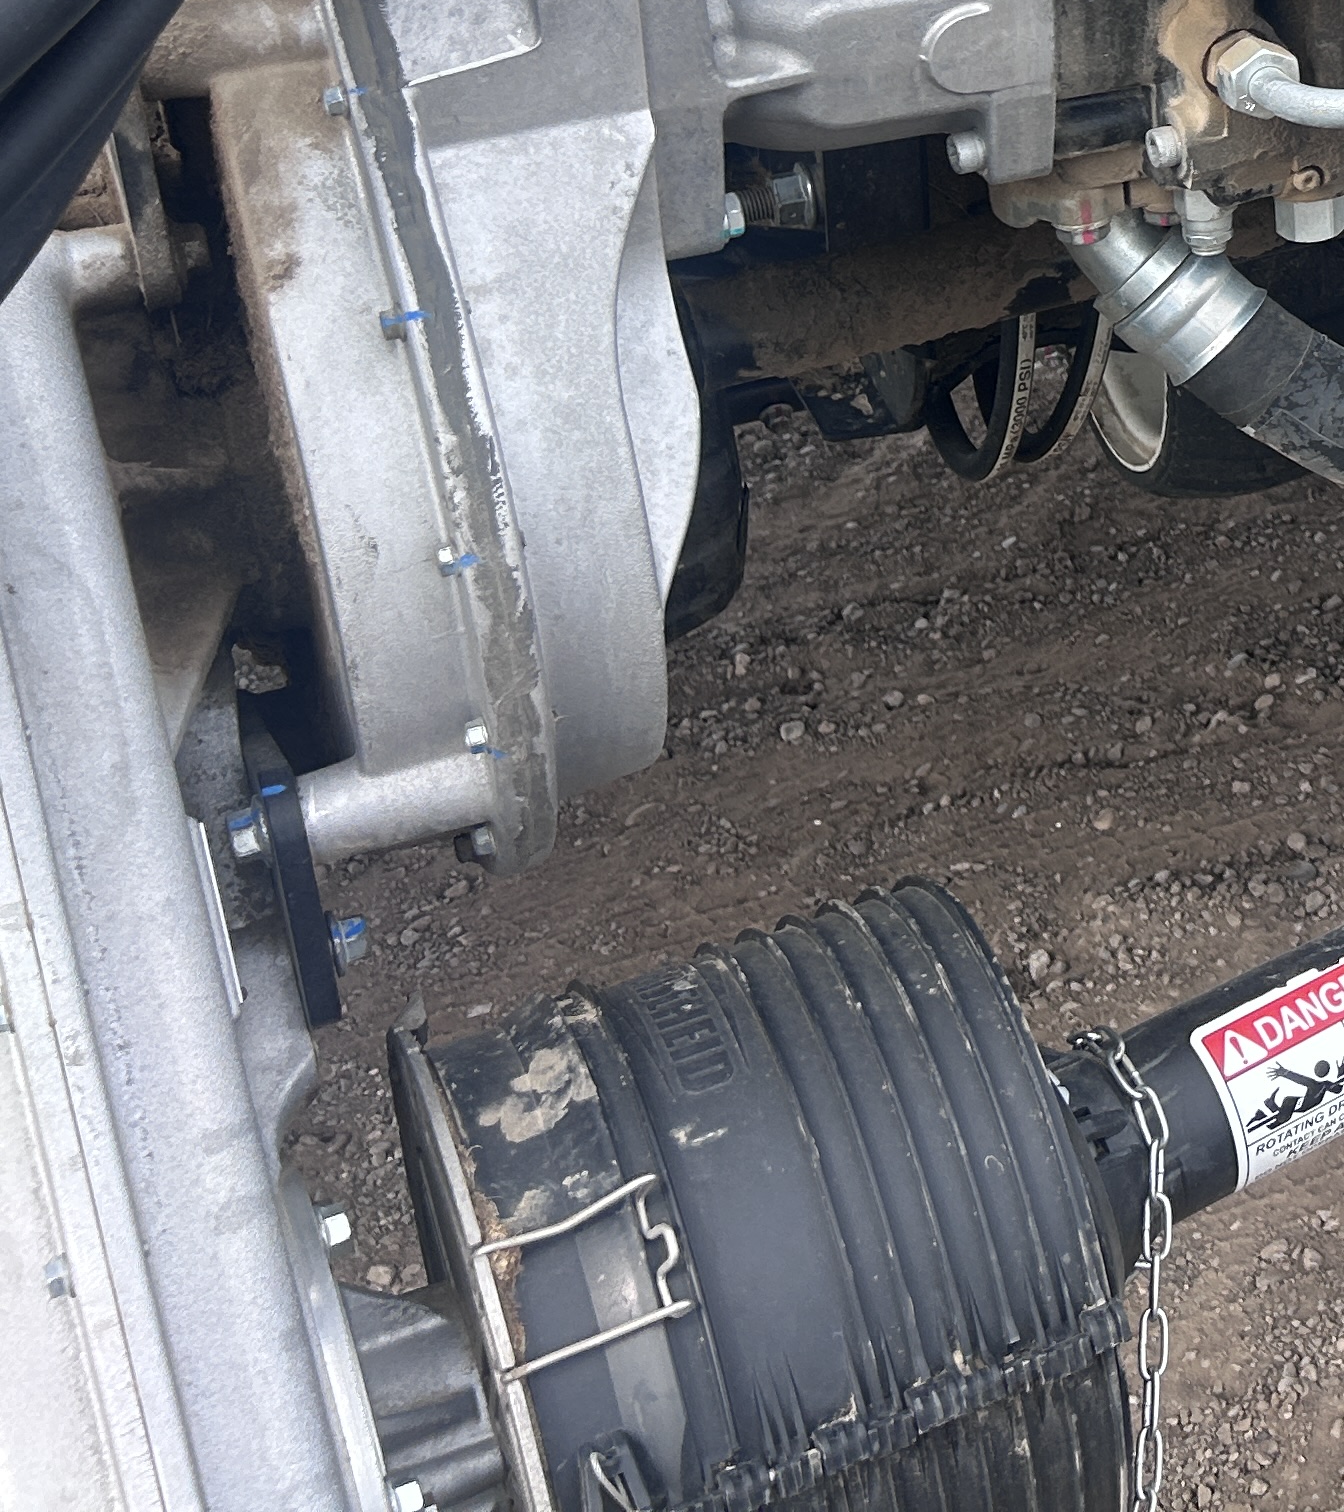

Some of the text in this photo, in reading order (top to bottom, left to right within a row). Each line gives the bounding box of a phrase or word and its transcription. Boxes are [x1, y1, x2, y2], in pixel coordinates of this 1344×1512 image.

[1255, 1112, 1324, 1156] ROTATING
[1272, 1129, 1316, 1157] CONTACT
[1317, 1118, 1337, 1132] CAN
[1286, 1125, 1333, 1158] KEEP
